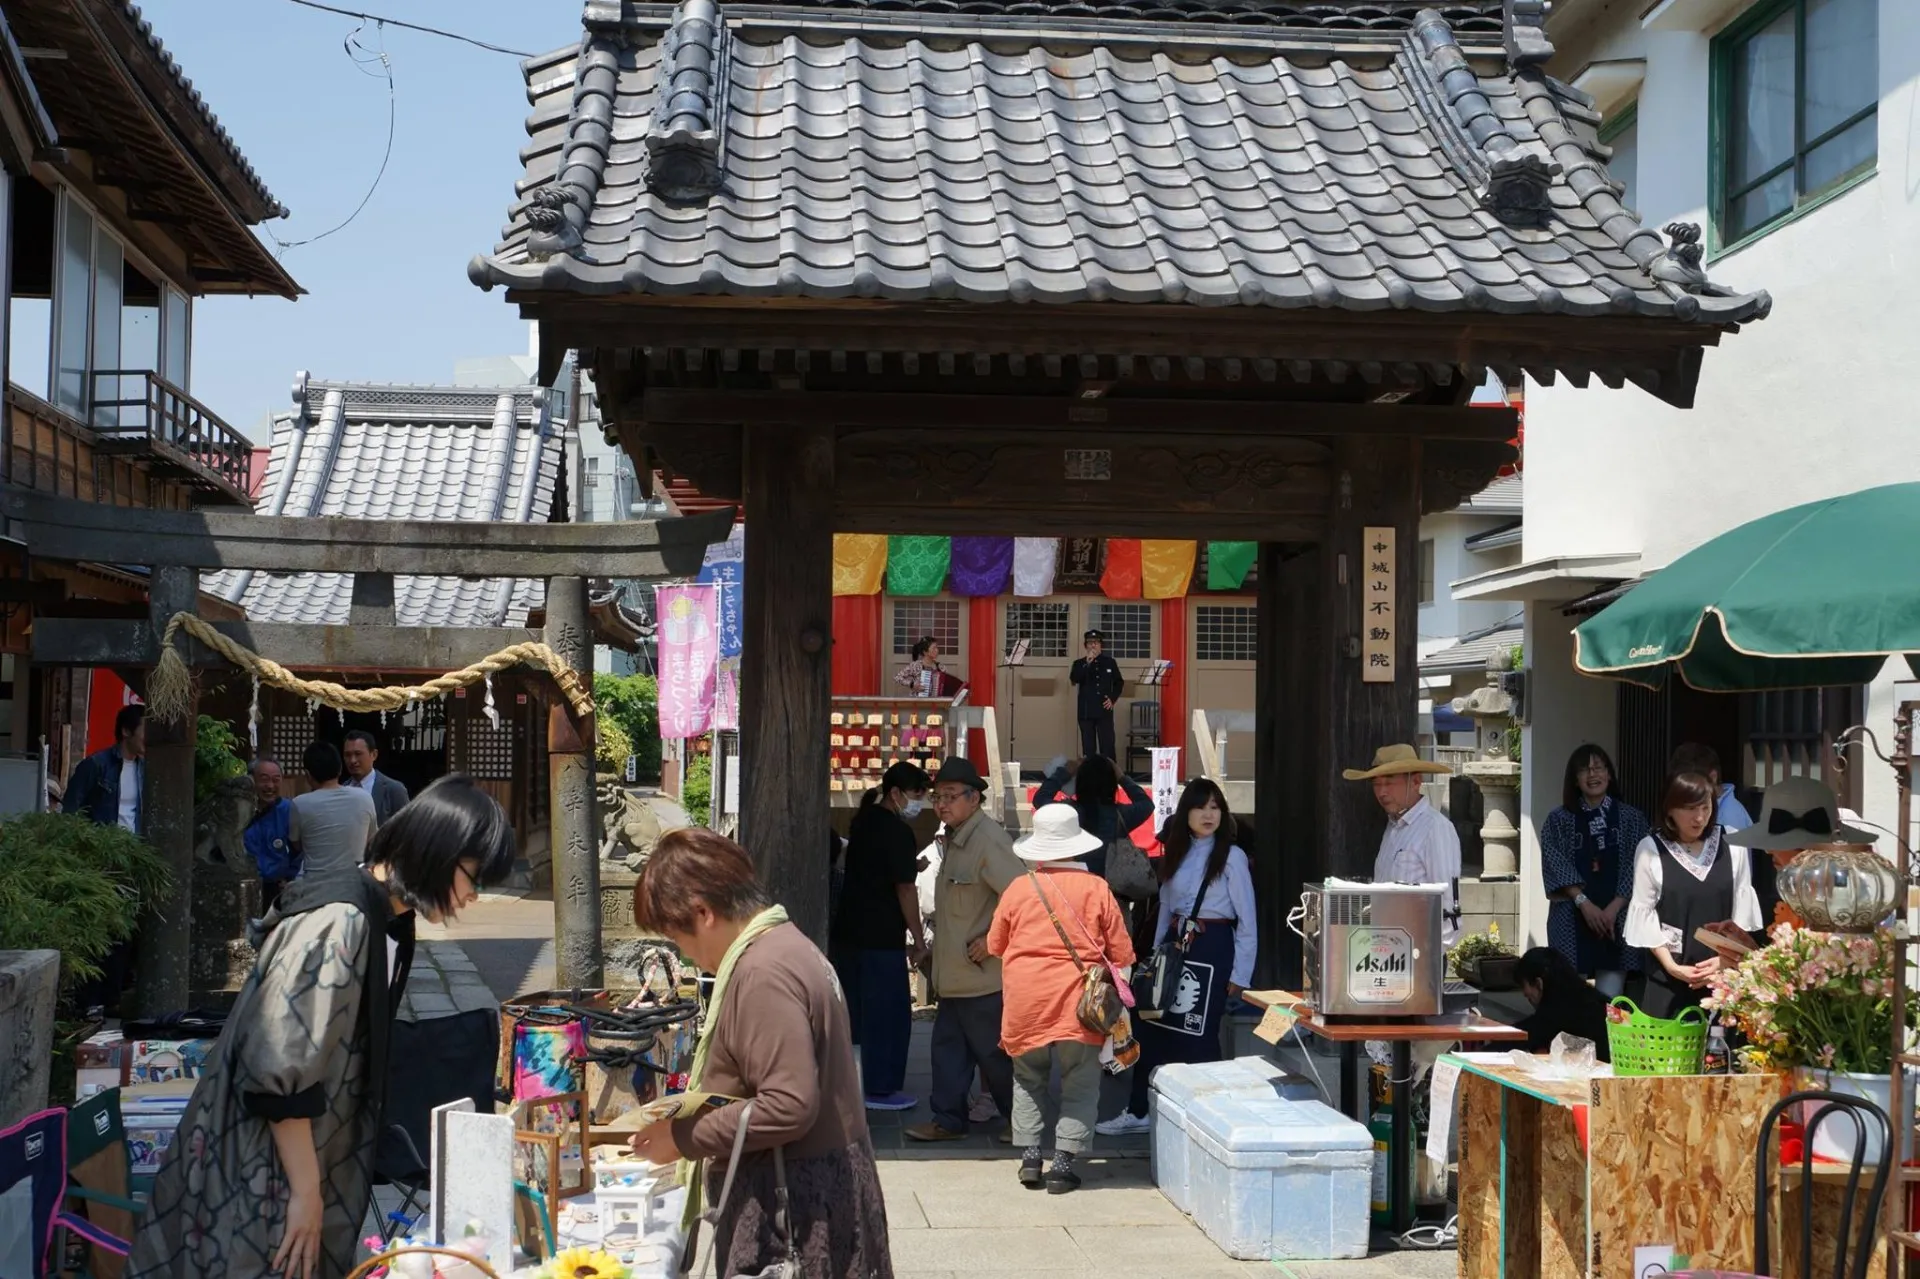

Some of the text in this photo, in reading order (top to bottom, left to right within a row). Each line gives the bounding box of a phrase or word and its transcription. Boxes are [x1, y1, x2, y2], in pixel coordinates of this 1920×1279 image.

[1369, 541, 1391, 667] 中城山不動院
[1355, 952, 1406, 974] Asahi
[1373, 976, 1387, 988] 生
